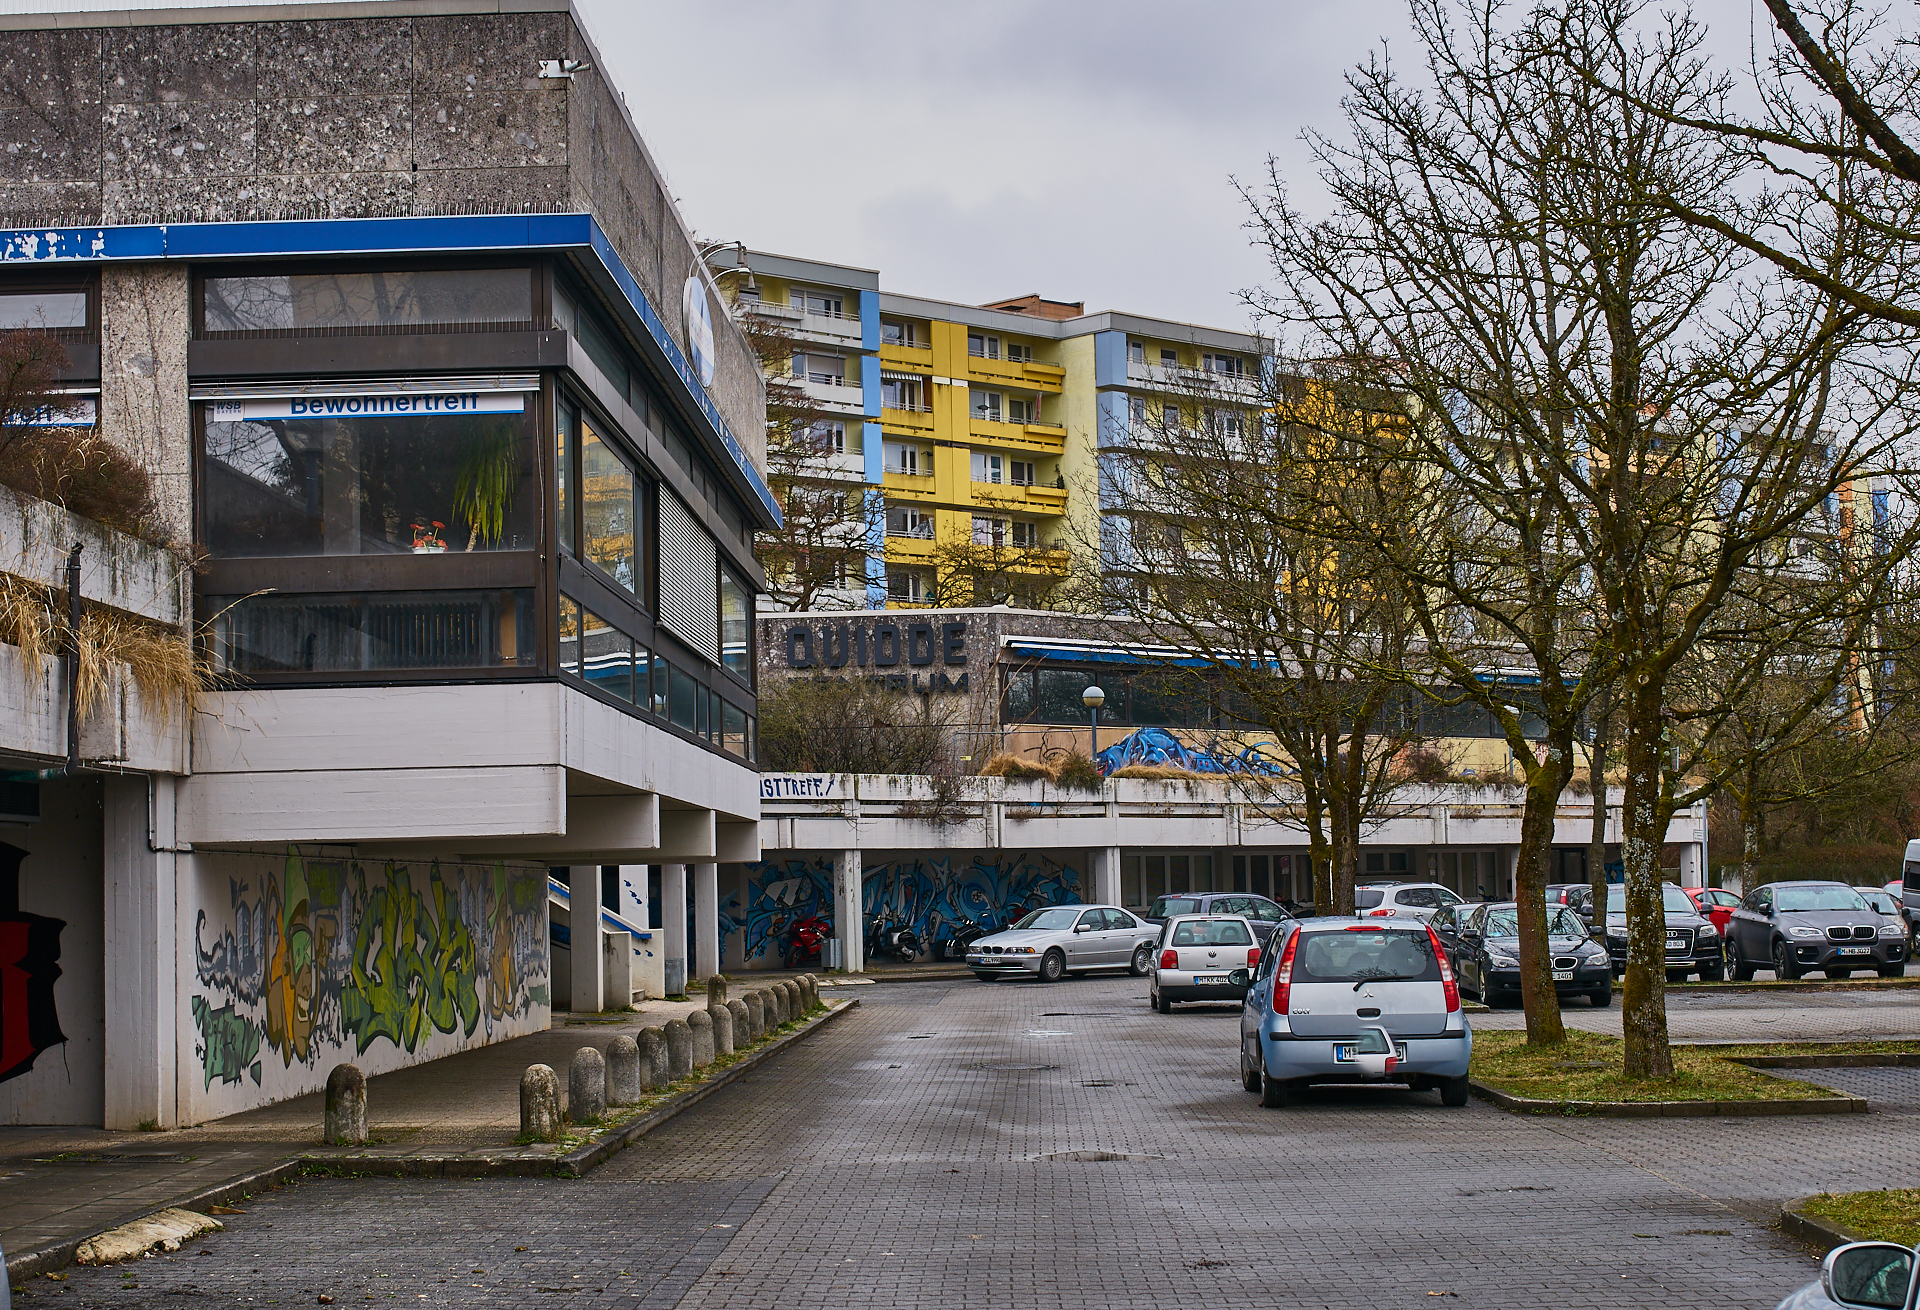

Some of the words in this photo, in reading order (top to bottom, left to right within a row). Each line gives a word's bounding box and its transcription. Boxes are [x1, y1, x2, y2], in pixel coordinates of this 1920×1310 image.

[216, 401, 242, 410] WSB
[290, 392, 480, 415] Bewohnertreff
[787, 622, 967, 668] QUIDDE
